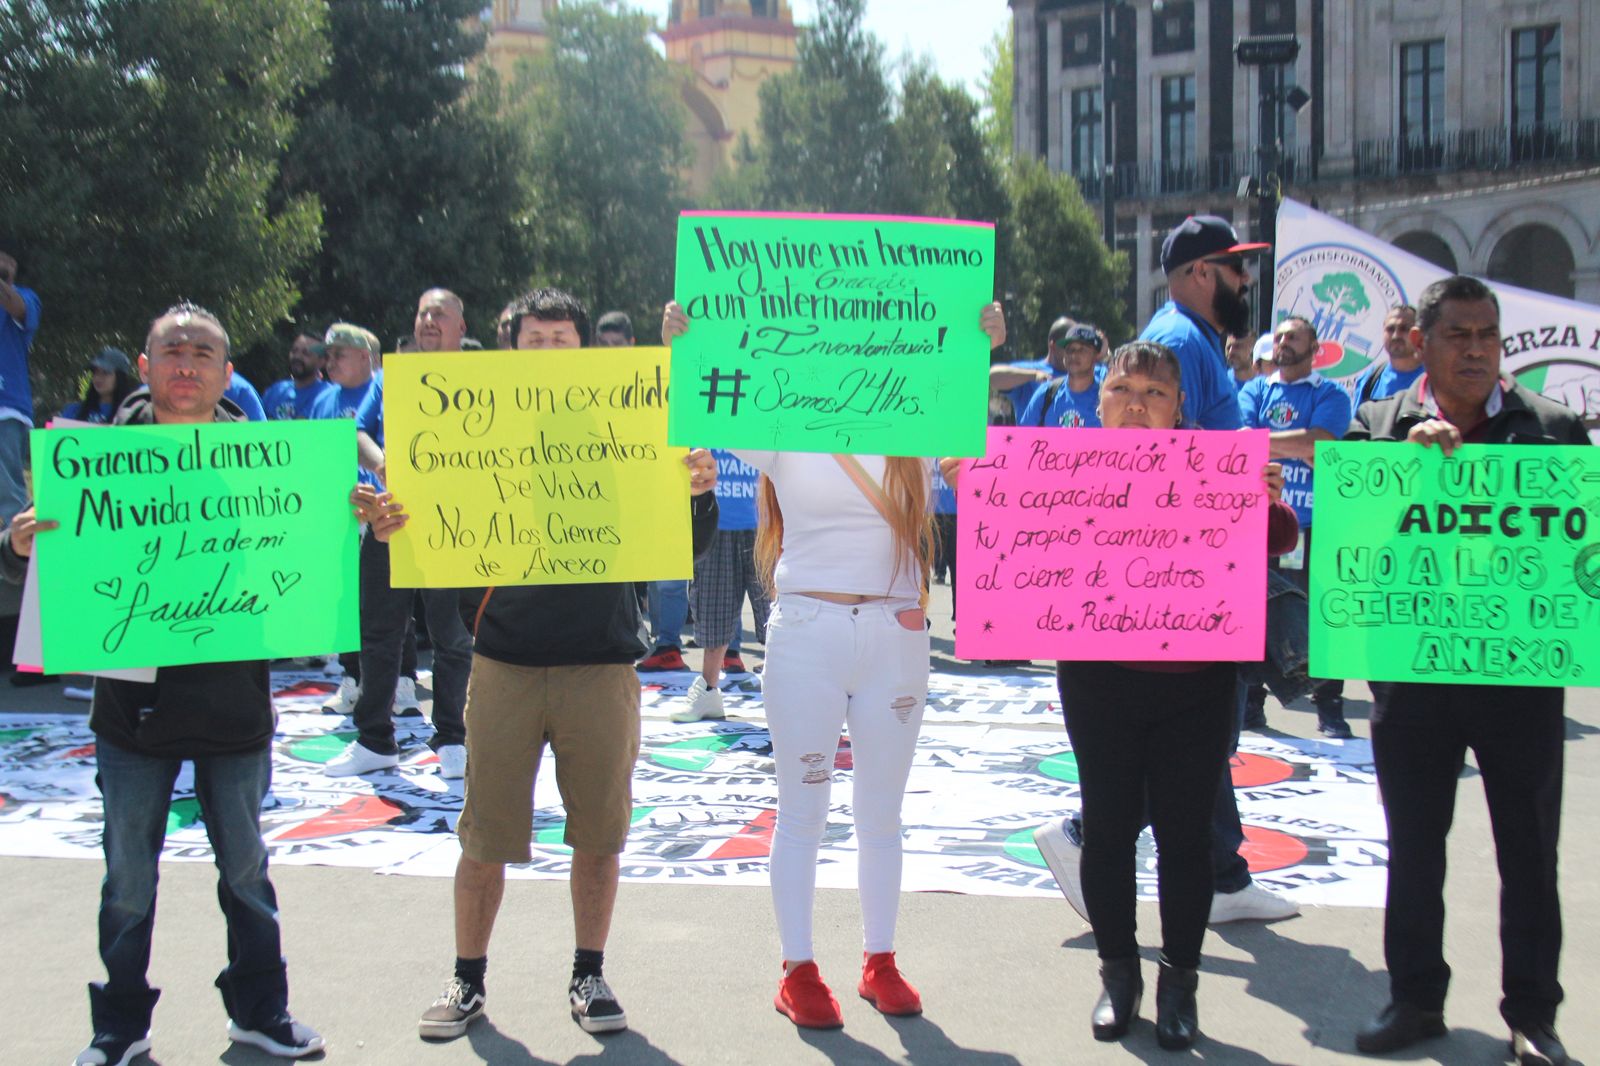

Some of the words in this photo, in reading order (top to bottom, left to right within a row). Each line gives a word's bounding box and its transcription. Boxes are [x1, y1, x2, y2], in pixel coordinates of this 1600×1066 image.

[694, 226, 763, 297] Hoy
[765, 236, 823, 268] vive
[829, 240, 869, 267] mi
[875, 228, 983, 267] hermano
[761, 275, 937, 322] internamiento
[1503, 326, 1580, 358] ERZA
[418, 372, 495, 438] Soy
[516, 386, 556, 413] un
[699, 367, 751, 416] #
[53, 436, 170, 480] Gracias
[176, 429, 202, 472] al
[210, 439, 291, 469] anexo
[409, 430, 515, 474] Gracias
[517, 446, 541, 467] a
[540, 430, 575, 464] los
[576, 421, 658, 463] centros
[1027, 440, 1167, 478] Recuperación
[1185, 436, 1206, 472] te
[1216, 443, 1249, 475] da
[492, 472, 532, 504] De
[539, 471, 611, 502] Vida
[1439, 455, 1503, 498] UN
[75, 488, 124, 536] Mi
[129, 485, 191, 527] vida
[200, 486, 302, 521] cambio
[986, 477, 1009, 508] la
[1019, 482, 1131, 515] capacidad
[1155, 481, 1182, 509] de
[1193, 490, 1263, 523] escoger
[1396, 502, 1587, 541] ADICTO
[428, 504, 476, 550] No
[483, 512, 504, 549] A
[547, 512, 622, 546] Cierres
[975, 520, 1000, 550] tu
[1010, 525, 1082, 554] propio
[1093, 524, 1178, 548] camino
[1199, 527, 1229, 549] no
[137, 536, 162, 575] y
[223, 528, 253, 554] de
[255, 531, 287, 551] mi
[474, 553, 504, 578] de
[522, 547, 607, 580] Anexo
[975, 563, 1002, 591] al
[1014, 565, 1074, 589] cierre
[1085, 560, 1109, 588] de
[1125, 556, 1205, 589] Centros
[1336, 547, 1398, 587] NO
[1408, 546, 1443, 587] A
[1455, 546, 1547, 590] LOS
[102, 562, 270, 654] familia
[1036, 604, 1065, 631] de
[1320, 588, 1510, 630] CIERRES
[1529, 594, 1579, 629] DE
